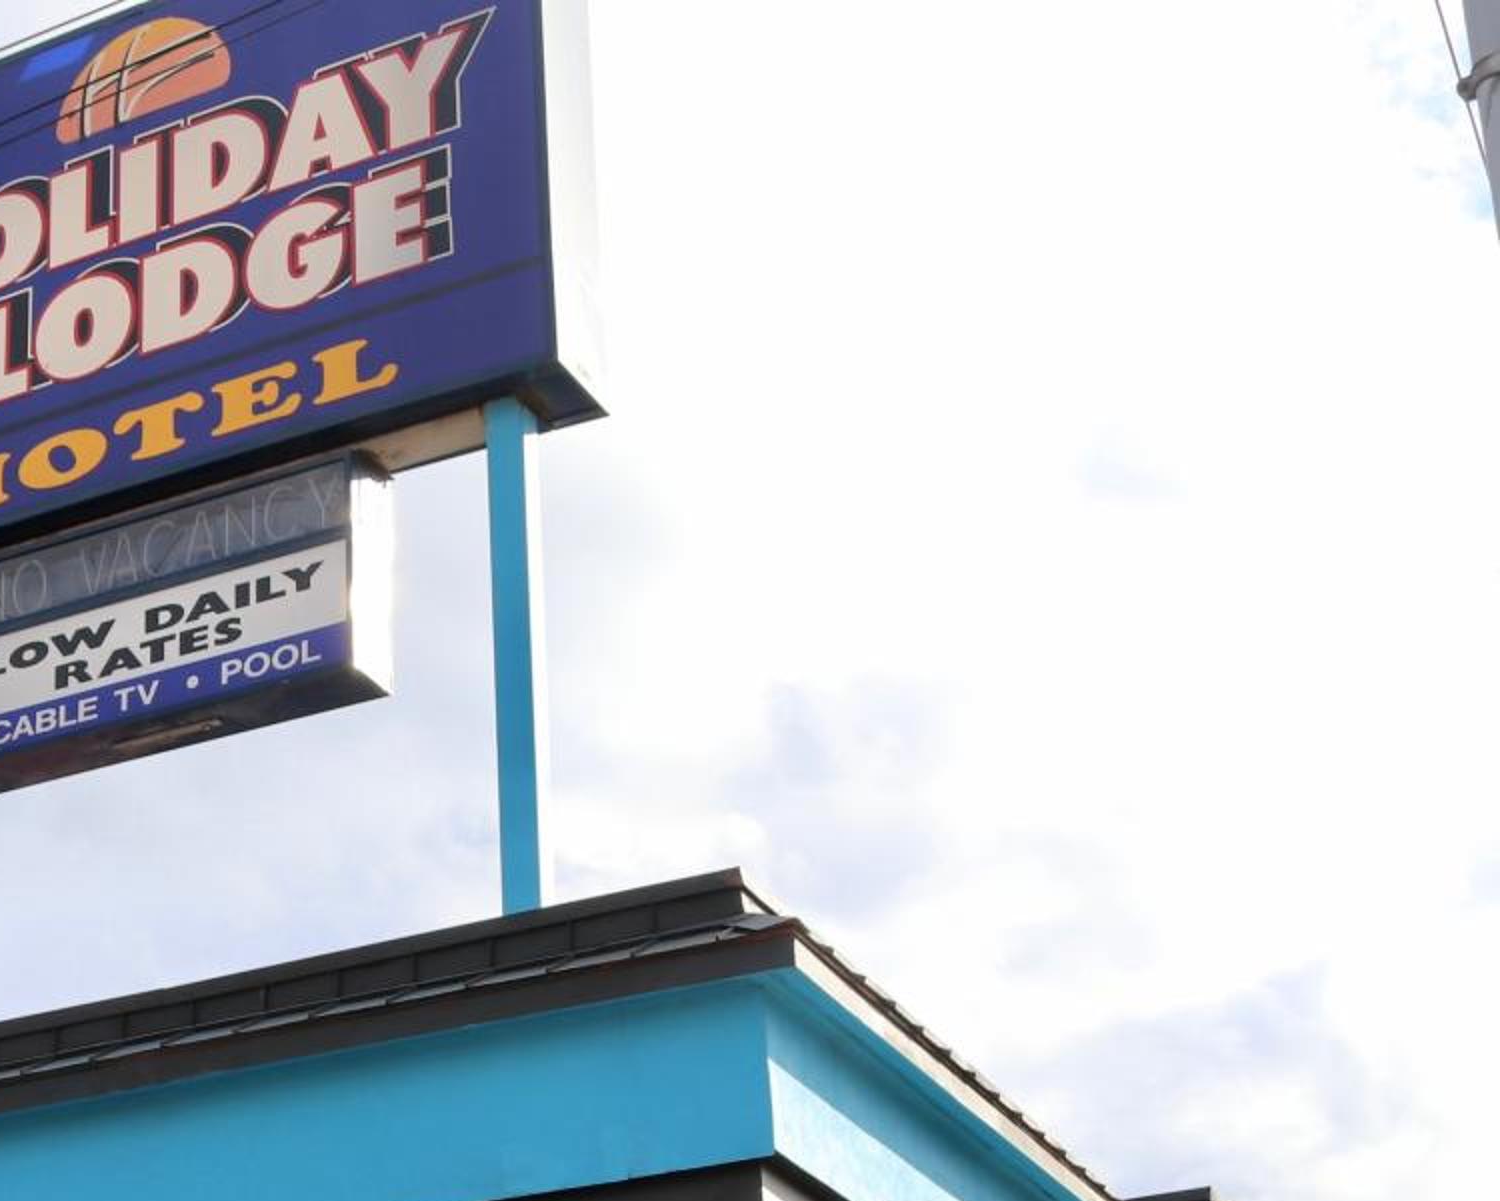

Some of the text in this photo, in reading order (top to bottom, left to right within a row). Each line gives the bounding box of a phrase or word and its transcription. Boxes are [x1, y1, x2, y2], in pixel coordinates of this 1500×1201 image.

[79, 474, 338, 594] VACANCY
[144, 559, 325, 634] DAILY
[54, 616, 244, 691] RATES
[114, 680, 160, 712] TV
[220, 639, 323, 686] POOL
